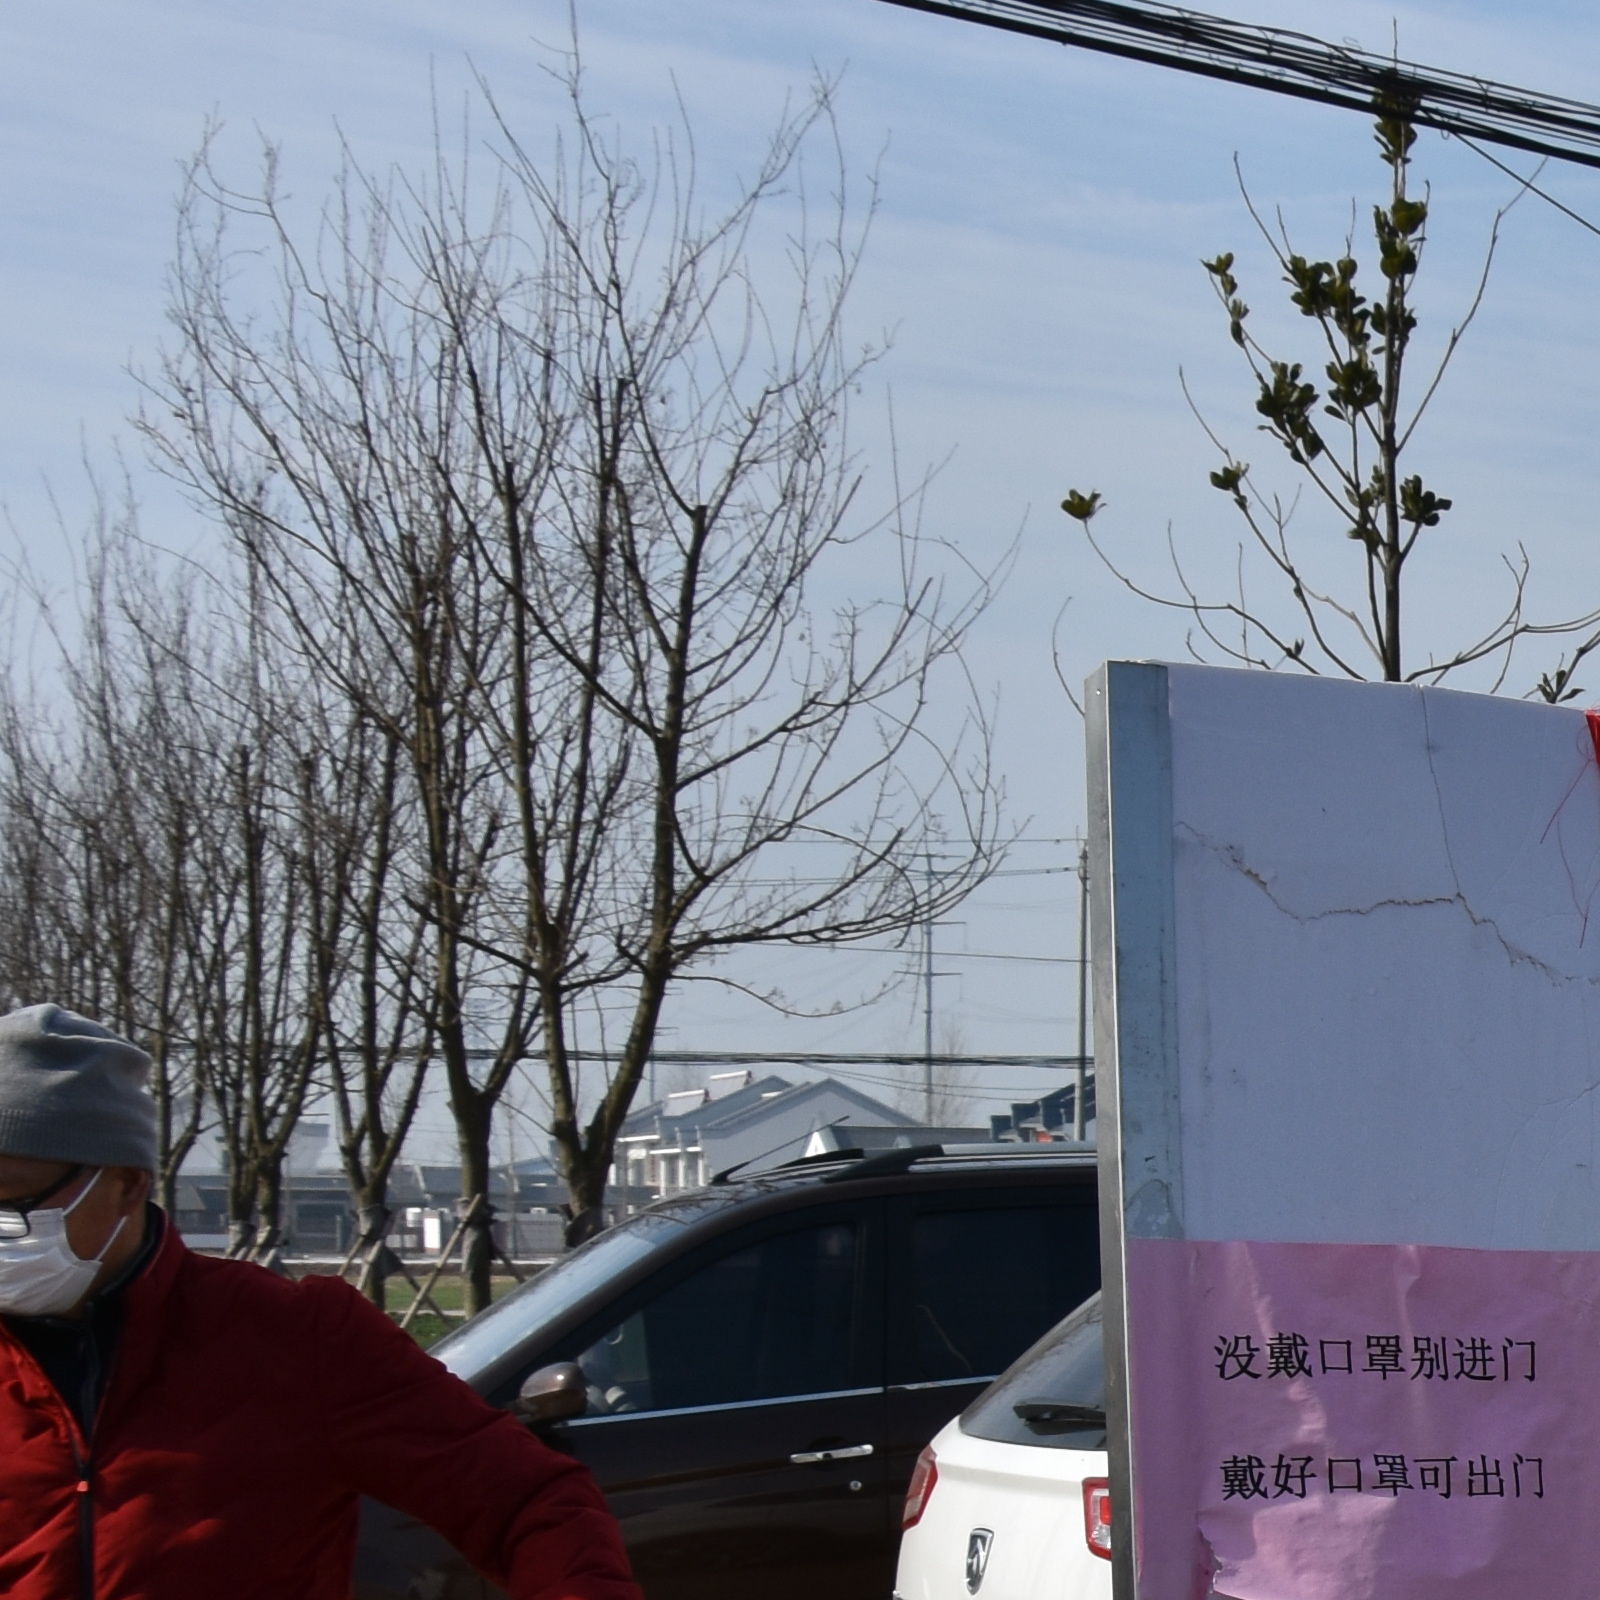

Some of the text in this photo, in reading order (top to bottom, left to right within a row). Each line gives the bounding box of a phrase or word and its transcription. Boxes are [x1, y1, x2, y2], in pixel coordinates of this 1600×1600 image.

[1213, 1332, 1539, 1383] 没戴口罩别进门
[1221, 1453, 1546, 1500] 戴好口罩可出门
